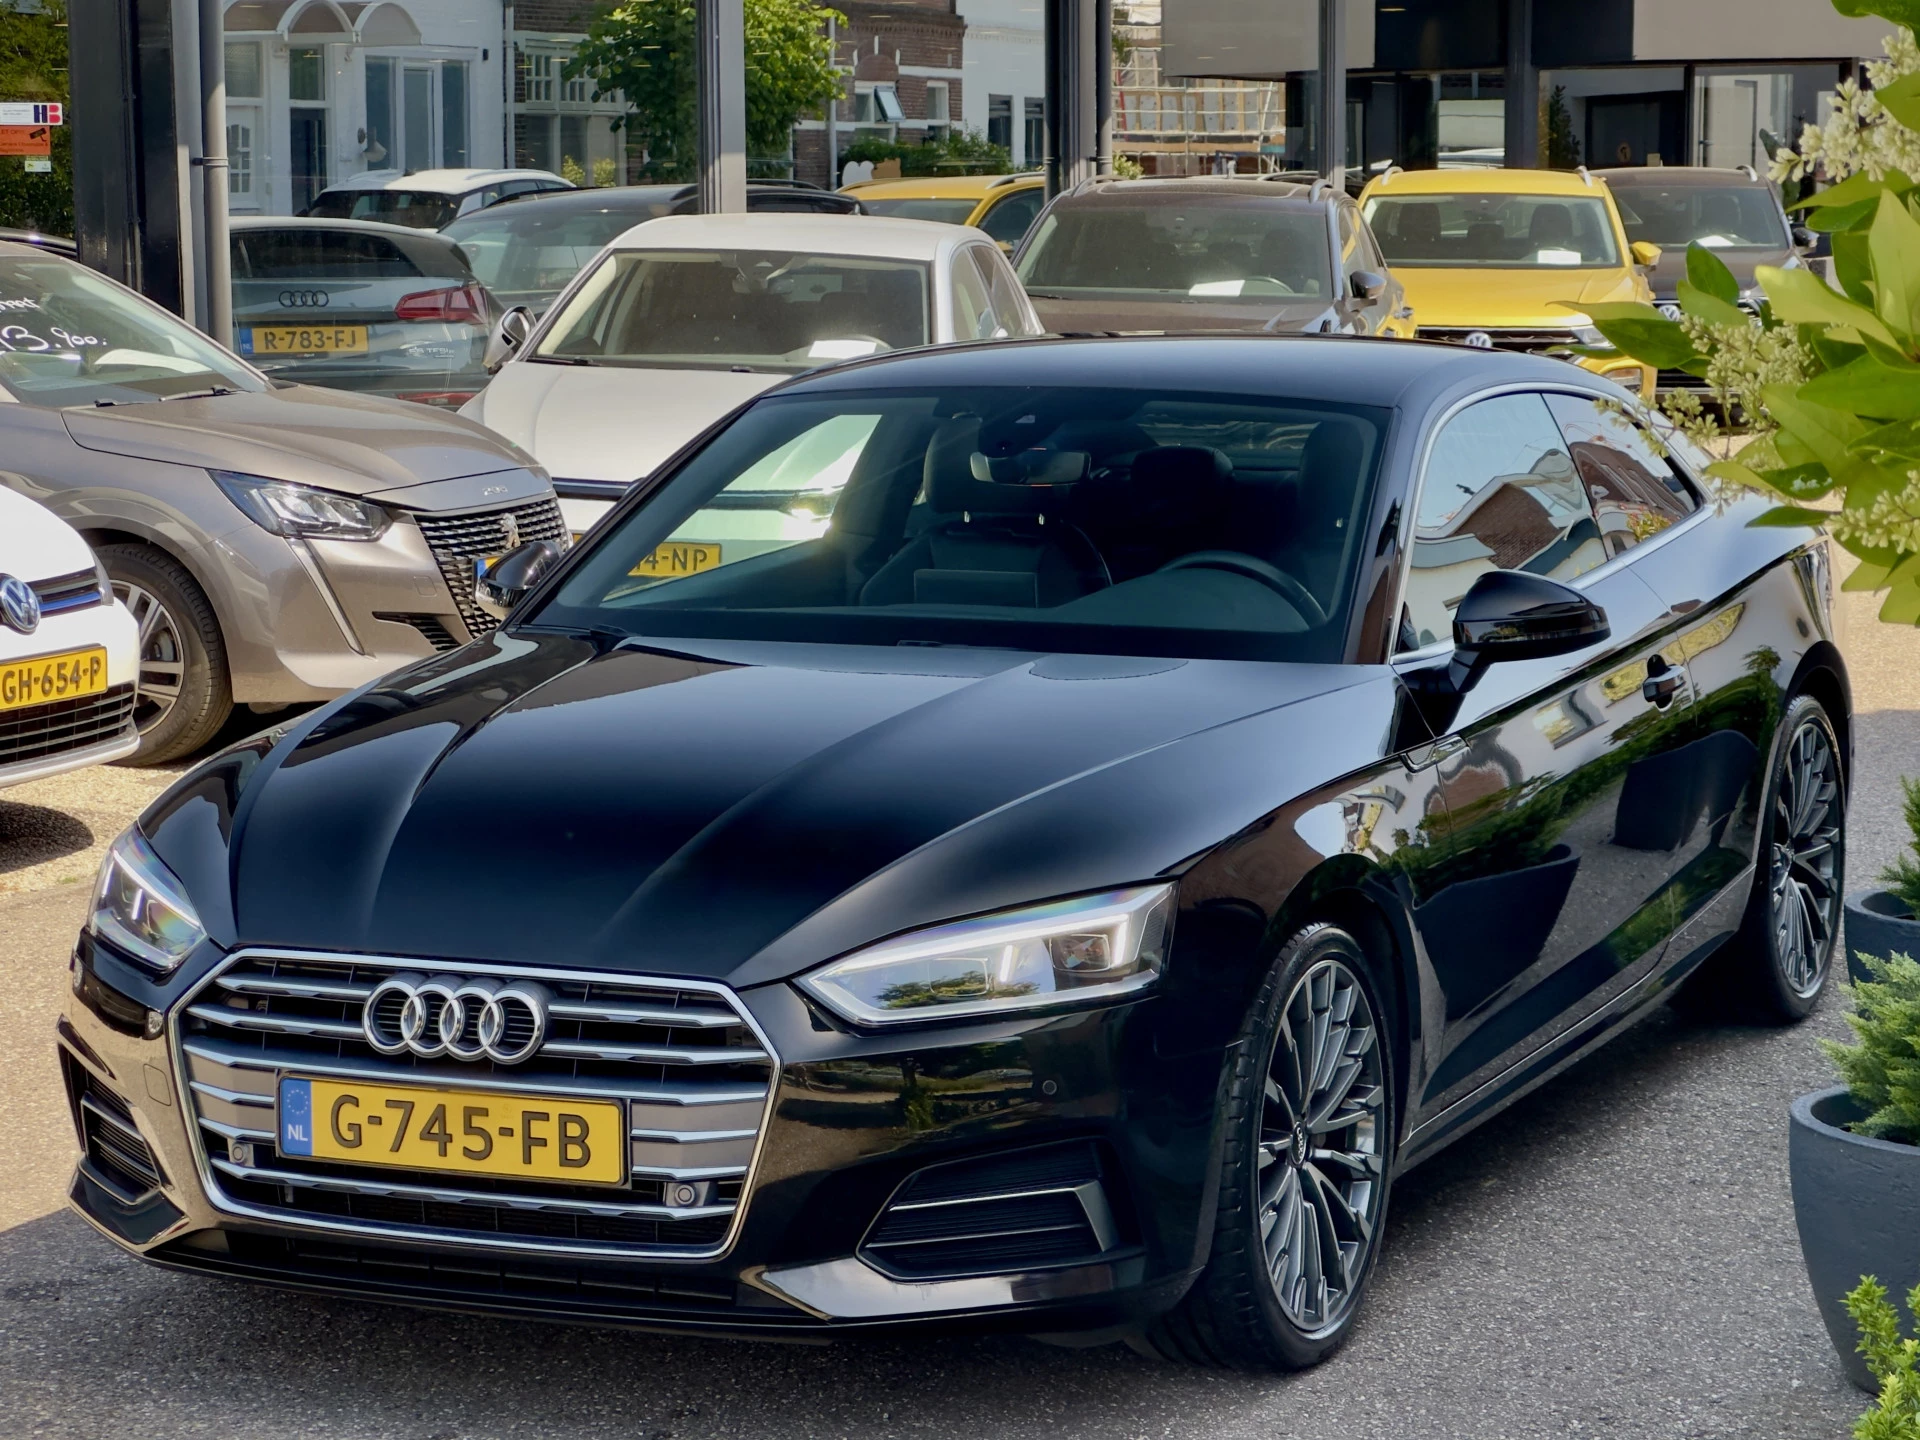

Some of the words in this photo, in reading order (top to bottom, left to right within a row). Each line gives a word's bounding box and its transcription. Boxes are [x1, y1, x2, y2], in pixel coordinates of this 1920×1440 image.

[264, 330, 356, 350] R-783-FJ
[637, 547, 708, 571] 4-NP
[2, 656, 101, 704] GH-654-P
[287, 1123, 308, 1142] NL
[330, 1094, 591, 1168] G-745-FB
